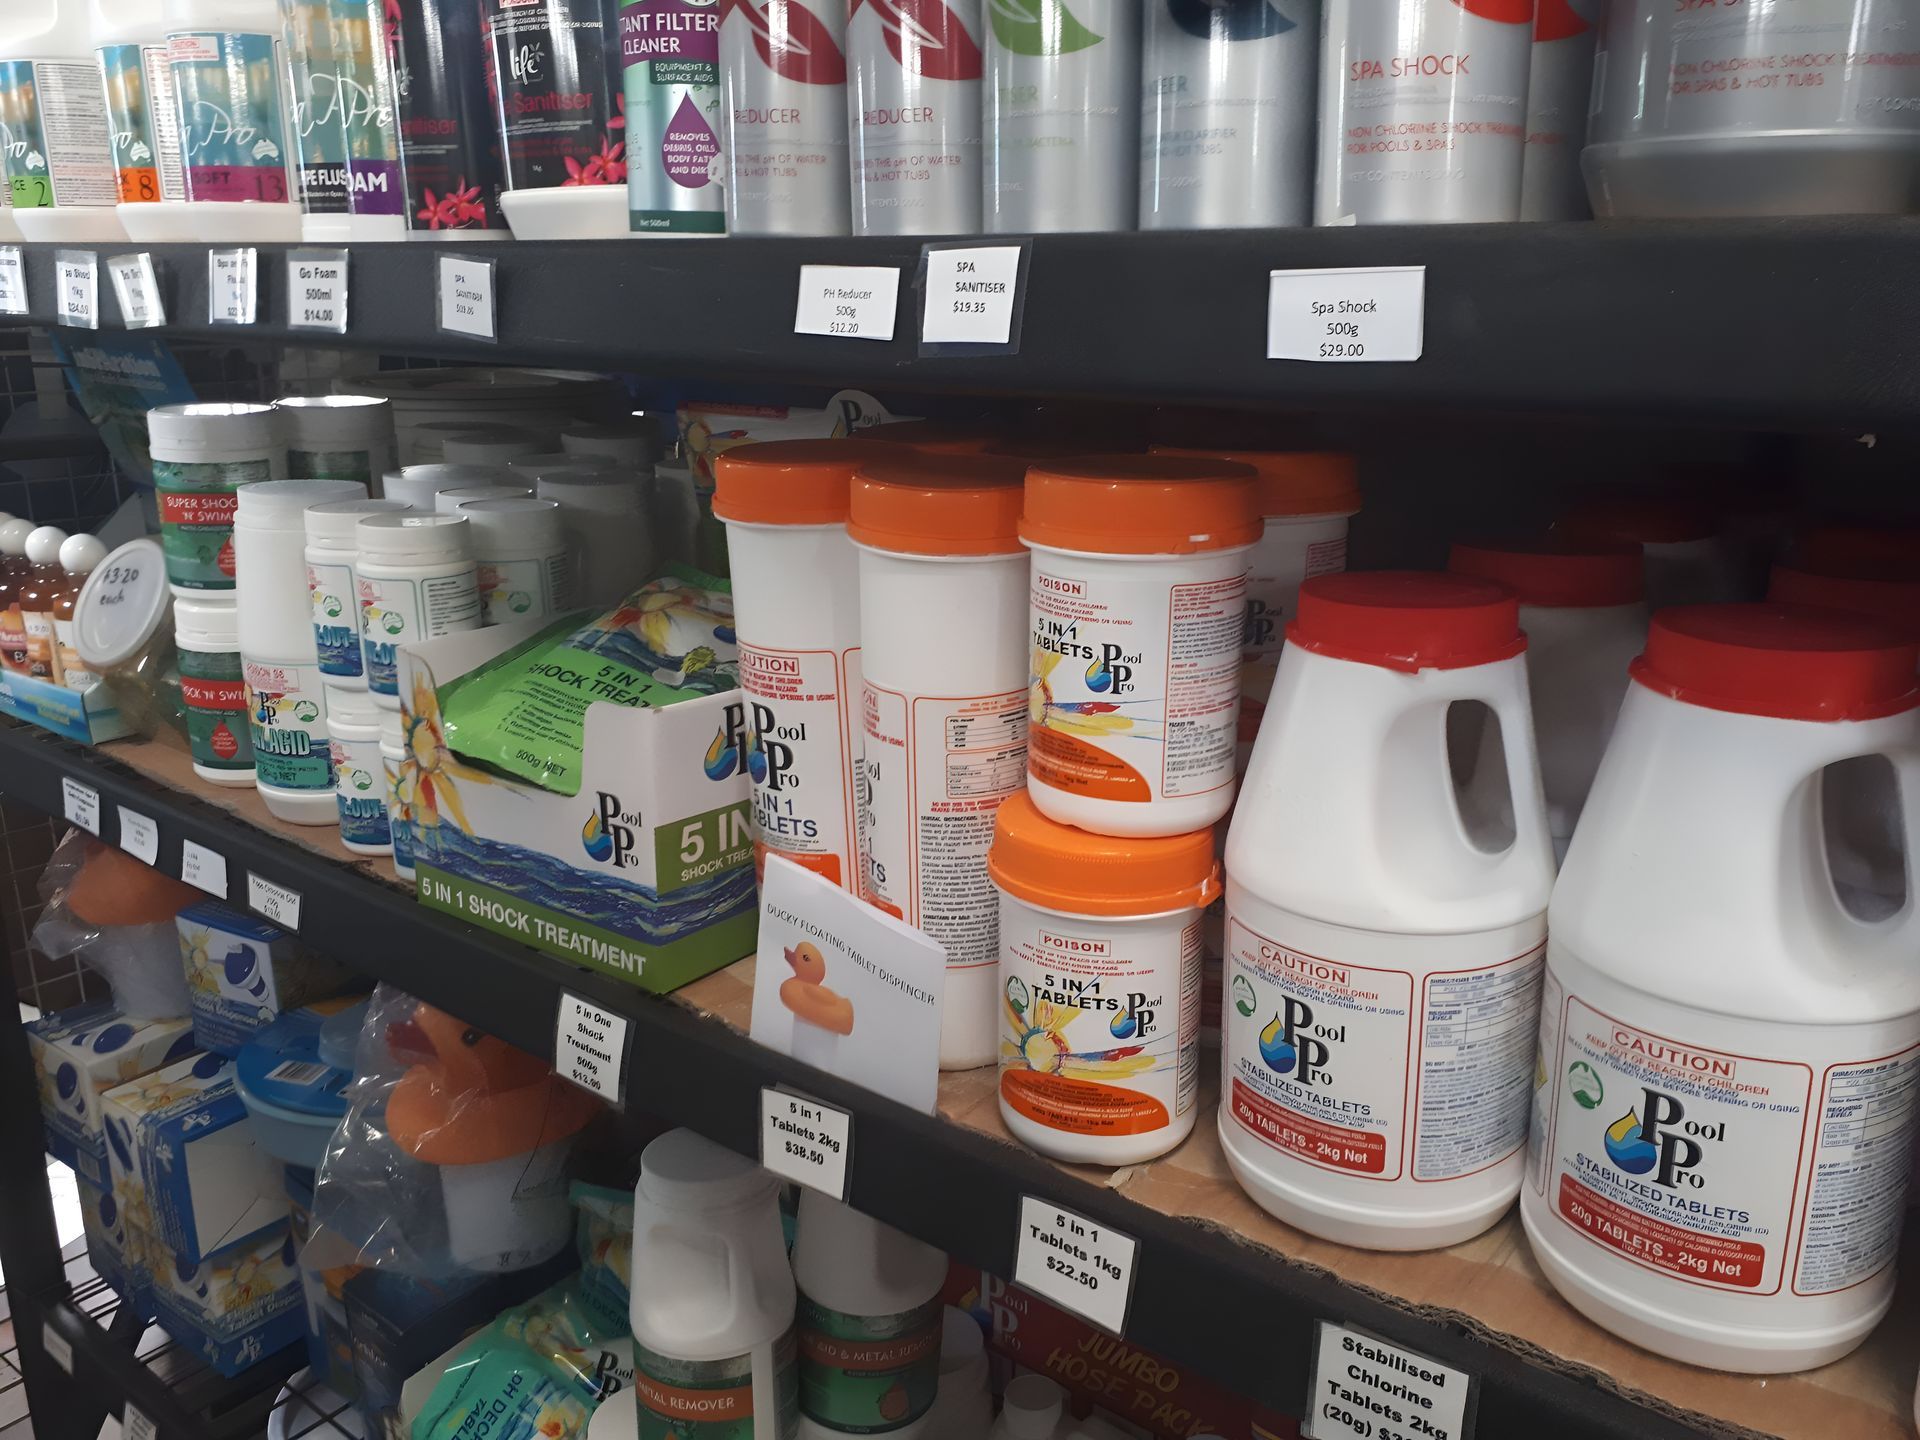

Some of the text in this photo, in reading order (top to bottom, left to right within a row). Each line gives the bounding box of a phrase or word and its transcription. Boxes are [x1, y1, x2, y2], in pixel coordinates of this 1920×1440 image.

[656, 13, 720, 32] FILTER
[624, 37, 681, 55] CLEANER
[1351, 54, 1471, 81] SPA SHOCK
[1786, 72, 1825, 87] TUBS
[734, 108, 800, 125] REDUCER
[863, 106, 934, 125] REDUCER
[669, 132, 710, 142] REMOVES
[667, 155, 690, 164] BODY
[670, 166, 689, 175] AND
[778, 153, 792, 164] OF
[911, 156, 924, 166] OF
[138, 175, 154, 200] 8
[299, 267, 339, 281] Go Foam
[956, 262, 976, 274] SPA
[305, 287, 333, 301] 500ml
[823, 288, 872, 301] PH Reducer
[954, 281, 1006, 295] SANITISER
[304, 308, 334, 323] $14.00
[836, 305, 856, 320] 500g
[953, 300, 986, 315] $19.35
[1311, 298, 1377, 316] Spa Shock
[829, 321, 859, 334] $12.20
[1326, 322, 1359, 339] 500g
[1320, 342, 1365, 358] $29.00
[166, 496, 198, 509] SUPER
[1039, 575, 1081, 594] POISON
[1038, 618, 1077, 640] 5 IN 1
[1032, 630, 1094, 660] TABLETS
[1101, 642, 1142, 674] Pool
[598, 665, 653, 694] 5 IN 1
[1110, 665, 1135, 695] Pro
[750, 701, 806, 755] Pool
[267, 728, 311, 756] ACID
[515, 749, 568, 778] 500g NET
[762, 739, 801, 792] Pro
[596, 790, 643, 836] Pool
[762, 792, 779, 813] IN
[785, 799, 794, 815] 1
[609, 823, 640, 870] Pro
[680, 820, 706, 864] 5
[681, 857, 724, 883] SHOCK
[422, 876, 647, 978] 5 IN 1 SHOCK TREATMENT
[767, 903, 936, 1005] DUCKY FLOATING TABLET DISPENCER
[1044, 935, 1105, 953] POISON
[1261, 945, 1346, 984] CAUTION
[1031, 984, 1119, 1010] TABLETS
[1045, 974, 1101, 995] 5 IN 1
[1284, 971, 1380, 1000] REACH OF CHILDREN
[1127, 992, 1163, 1020] Pool
[1280, 994, 1346, 1044] Pool
[577, 1022, 605, 1043] Shock
[594, 1013, 612, 1028] One
[1135, 1009, 1157, 1039] Pro
[566, 1034, 612, 1064] Treatment
[1293, 1034, 1333, 1086] Pro
[1614, 1031, 1731, 1077] CAUTION
[577, 1056, 598, 1075] 500g
[1630, 1053, 1646, 1065] OF
[1647, 1057, 1689, 1078] REACH
[1690, 1071, 1704, 1084] OF
[1707, 1078, 1770, 1096] CHILDREN
[1241, 1057, 1371, 1116] STABILIZED TABLETS
[790, 1101, 822, 1122] 5 in 1
[1703, 1092, 1749, 1108] OPENING
[1751, 1100, 1767, 1111] OR
[1768, 1104, 1801, 1114] USING
[1636, 1086, 1725, 1151] Pool
[770, 1115, 840, 1153] Tablets 2kg
[1256, 1114, 1306, 1147] TABLETS
[1316, 1142, 1341, 1161] 2kg
[1345, 1149, 1368, 1164] Net
[785, 1140, 824, 1165] $38.50
[1651, 1131, 1706, 1190] Pro
[1576, 1152, 1751, 1224] STABILIZED TABLETS
[1056, 1213, 1098, 1243] 5 in 1
[1571, 1202, 1742, 1277] 20g TABLETS 2kg Net
[1030, 1224, 1122, 1280] Tablets 1kg
[1046, 1255, 1098, 1290] $22.50
[596, 1350, 633, 1380] Pool
[853, 1349, 895, 1362] METAL
[1077, 1333, 1180, 1393] JUMBO
[1342, 1336, 1446, 1388] Stabilised
[1045, 1346, 1216, 1437] HOSE PACK
[1347, 1364, 1433, 1410] Chlorine
[670, 1396, 735, 1412] REMOVER
[1327, 1379, 1448, 1440] Tablets 2kg
[1322, 1402, 1372, 1438] (20g)
